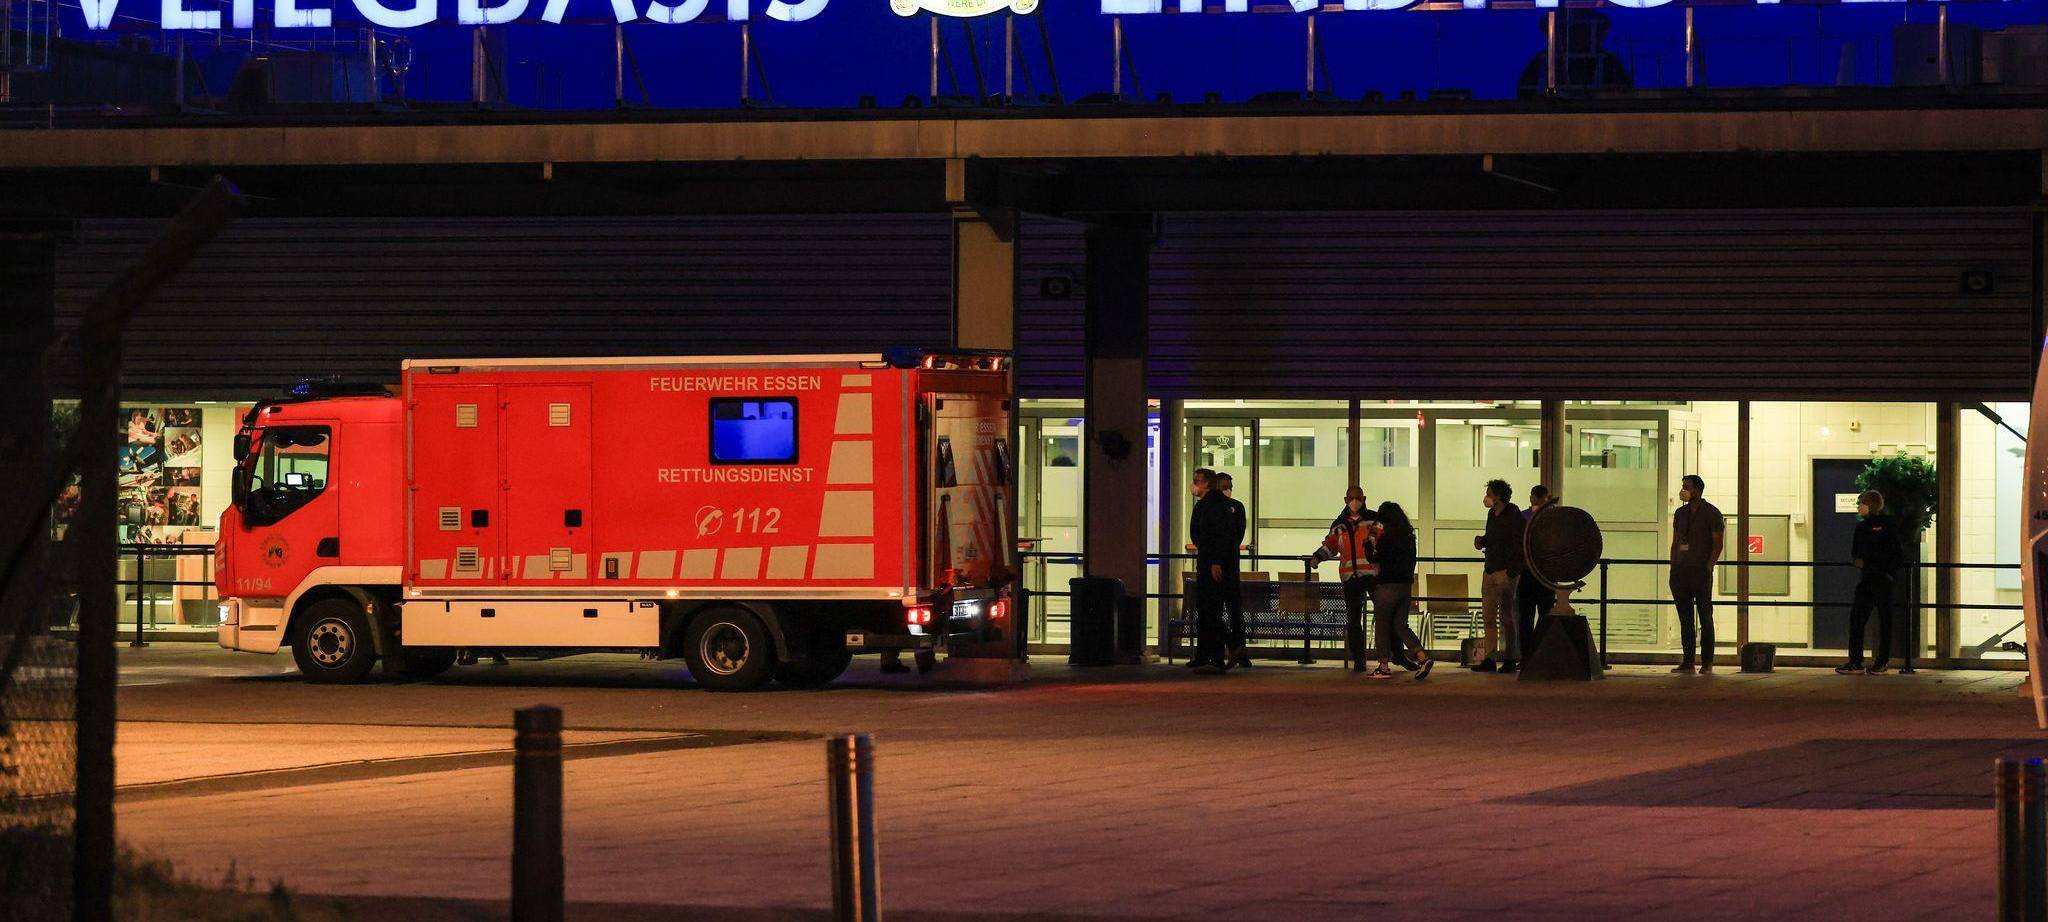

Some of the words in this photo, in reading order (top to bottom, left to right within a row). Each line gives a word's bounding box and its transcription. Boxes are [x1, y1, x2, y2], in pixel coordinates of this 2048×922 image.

[650, 376, 758, 391] FEUERWEHR
[763, 375, 821, 391] ESSEN
[658, 467, 814, 483] RETTUNGSDIENST
[732, 507, 781, 533] 112
[237, 577, 273, 592] 11/94
